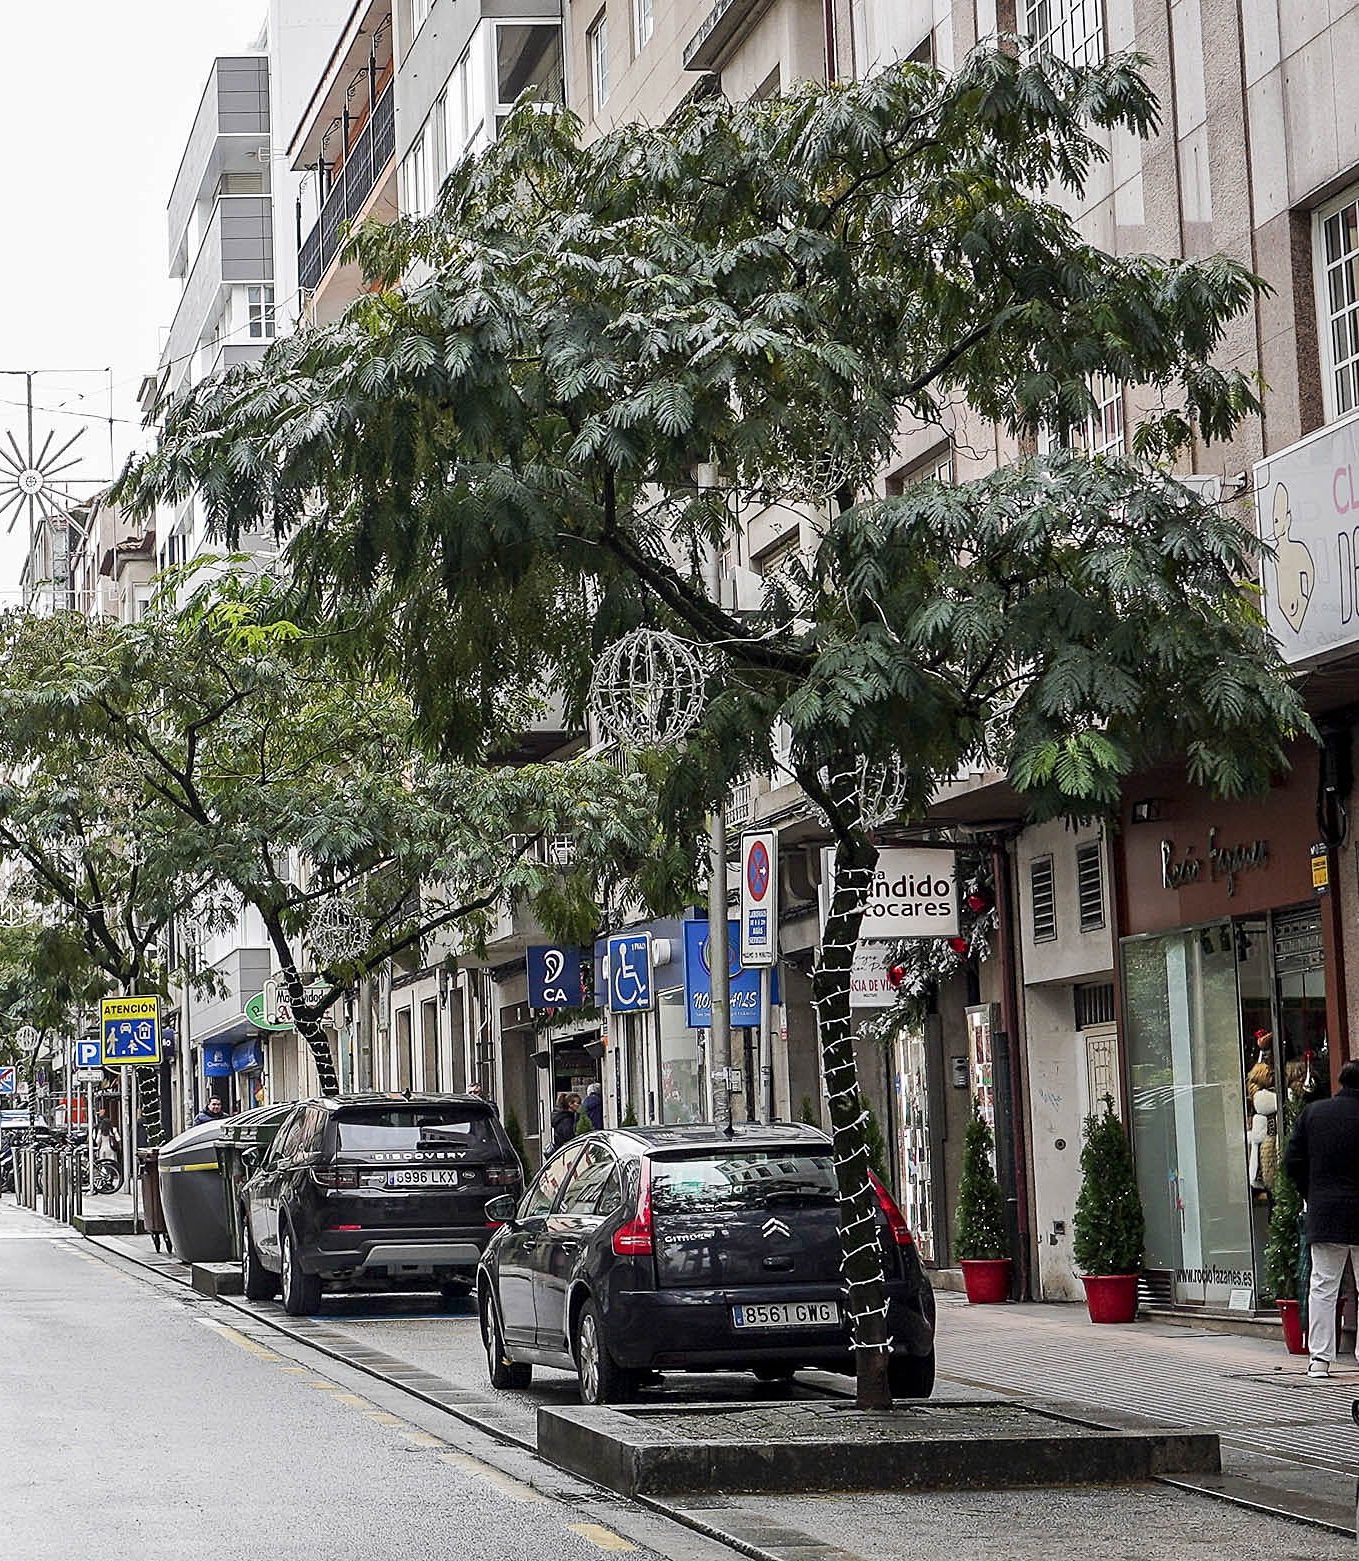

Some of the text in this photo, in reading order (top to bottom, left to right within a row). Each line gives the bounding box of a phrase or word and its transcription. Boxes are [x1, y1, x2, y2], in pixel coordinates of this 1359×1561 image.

[868, 979, 879, 992] DE
[543, 988, 568, 1002] CA
[104, 1003, 156, 1015] ATENCIÓN
[82, 1044, 97, 1064] P
[374, 1151, 467, 1161] DISCOVERY
[396, 1171, 427, 1184] 6996
[431, 1170, 455, 1184] LKX
[745, 1304, 831, 1324] 8561 GWG
